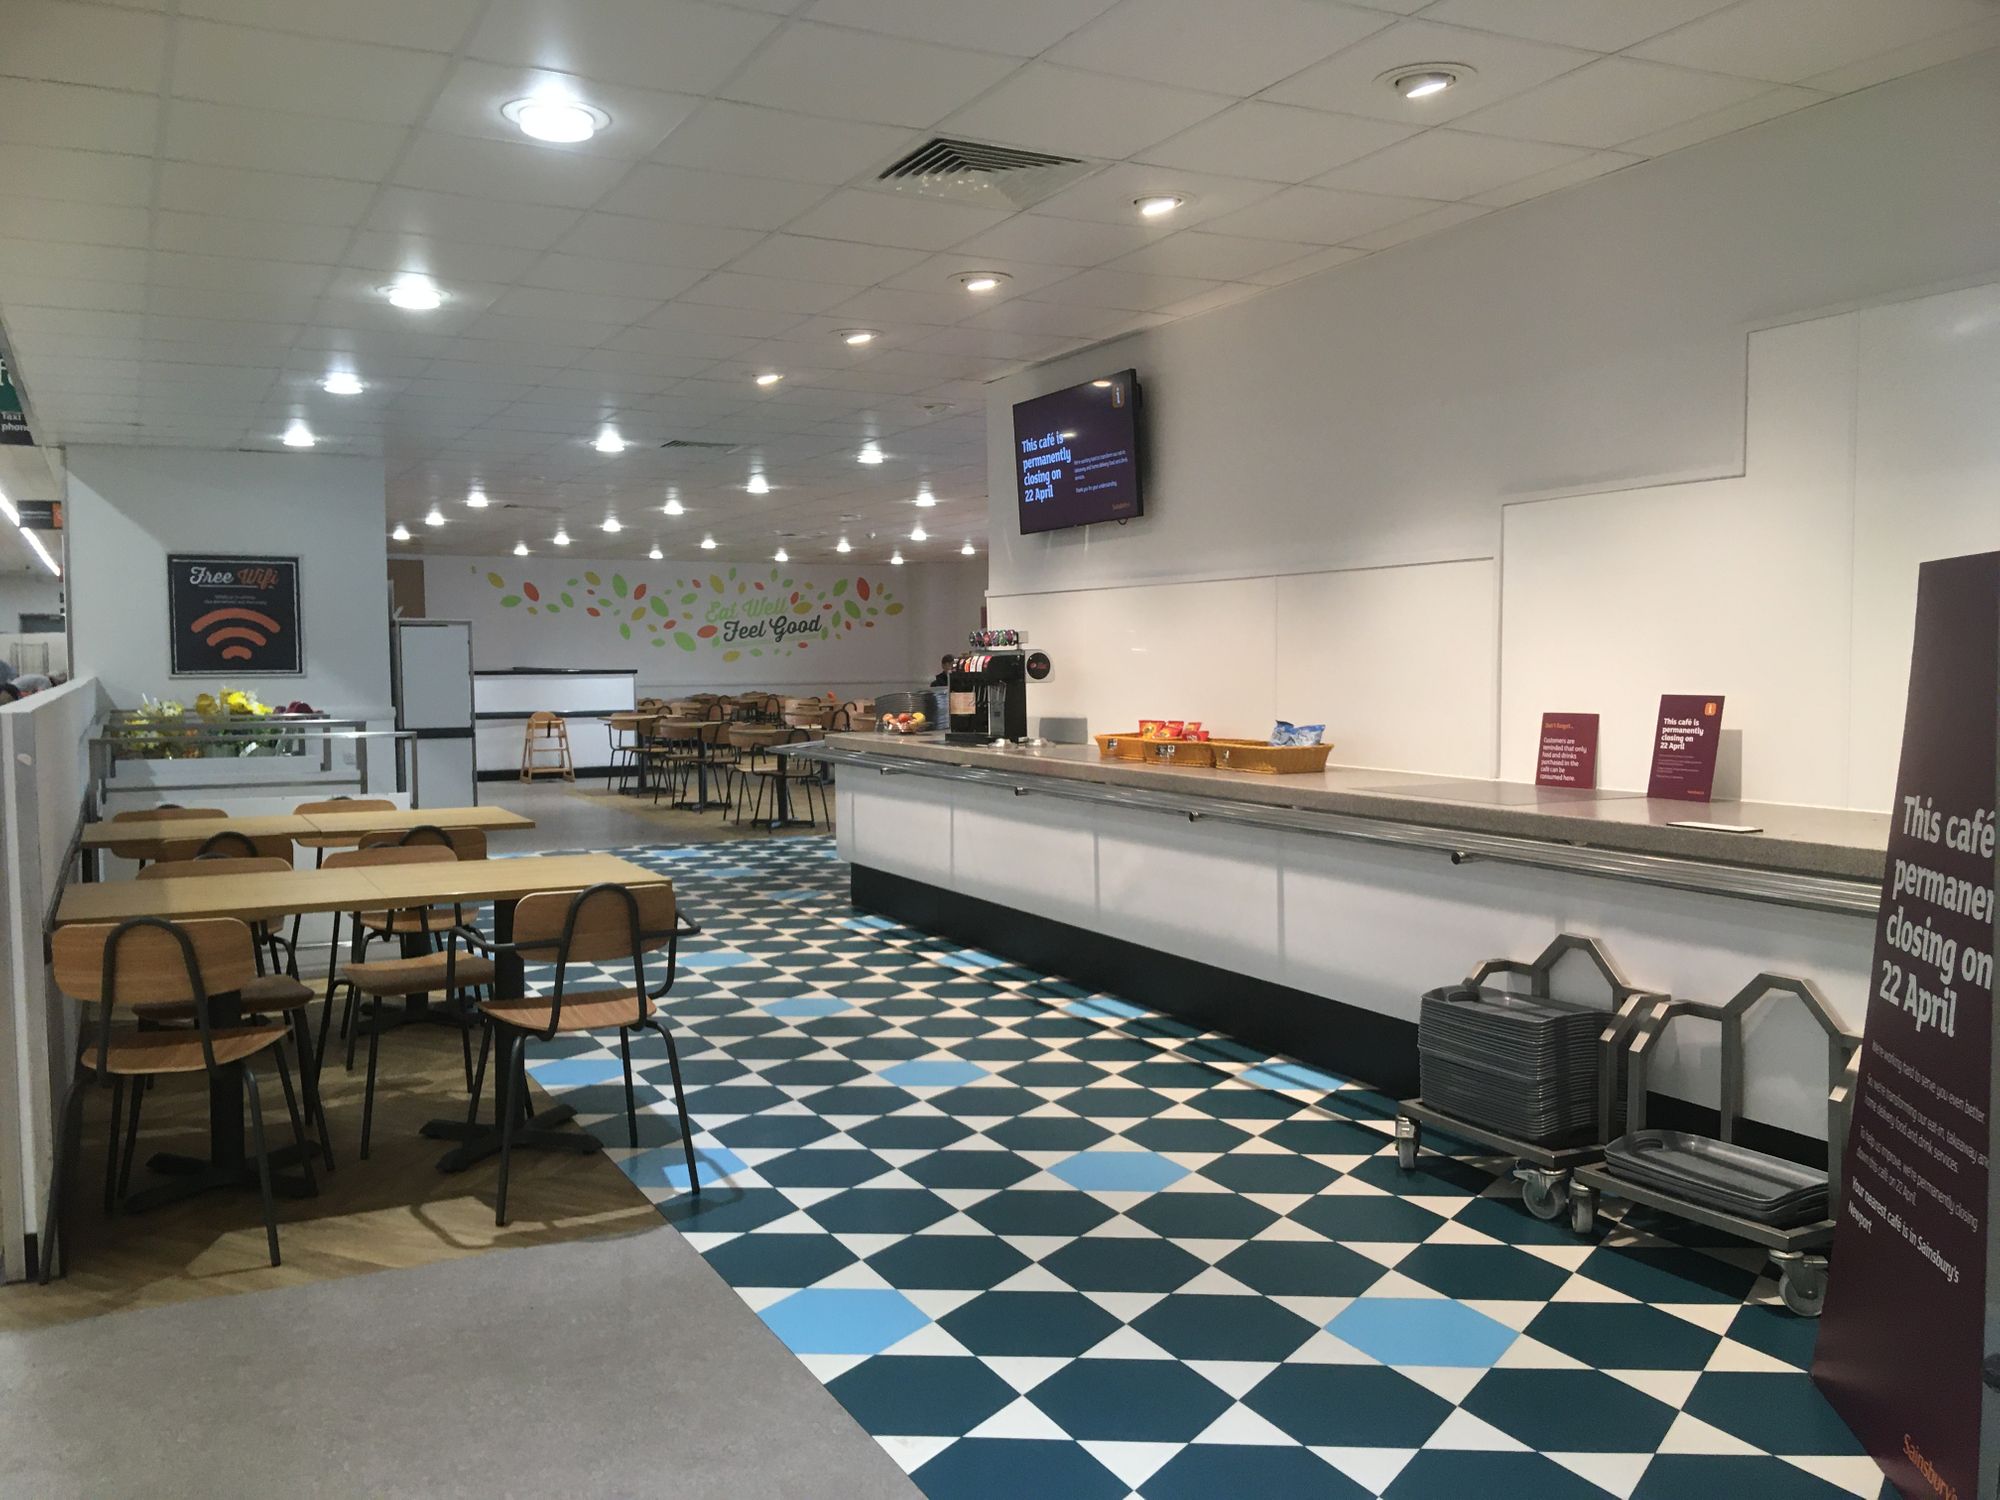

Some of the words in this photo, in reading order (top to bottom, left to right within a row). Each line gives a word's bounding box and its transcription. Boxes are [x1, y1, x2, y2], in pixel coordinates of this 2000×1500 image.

[2, 412, 22, 420] Taxi
[1022, 438, 1038, 453] This
[1039, 432, 1055, 449] café
[1056, 430, 1064, 444] is
[1022, 446, 1072, 473] permanently
[1024, 469, 1051, 486] closing
[1051, 468, 1062, 480] on
[1024, 489, 1034, 503] 22
[1035, 484, 1054, 503] April
[189, 566, 234, 585] Free
[237, 567, 279, 590] Wifi
[704, 600, 737, 623] Eat
[742, 596, 789, 618] Well
[723, 619, 767, 643] Feel
[768, 614, 823, 643] Good
[1662, 726, 1704, 736] permanently
[1663, 717, 1677, 726] This
[1678, 717, 1693, 727] café
[1693, 718, 1700, 727] is
[1575, 745, 1588, 754] only
[1660, 742, 1668, 750] 22
[1668, 742, 1685, 751] April
[1661, 735, 1684, 743] closing
[1561, 752, 1577, 760] drinks
[1903, 795, 1942, 844] This
[1945, 808, 1996, 858] café
[1886, 905, 1957, 985] closing
[1961, 947, 1993, 990] on
[1880, 960, 1902, 1007] 22
[1903, 972, 1957, 1038] April
[1921, 1075, 1936, 1093] serve
[1936, 1086, 1948, 1101] you
[1948, 1093, 1964, 1111] even
[1895, 1115, 1907, 1136] food
[1907, 1127, 1918, 1145] and
[1918, 1134, 1933, 1155] drink
[1917, 1112, 1927, 1126] our
[1946, 1129, 1977, 1164] takeaway
[1848, 1200, 1872, 1234] Newport
[1917, 1175, 1954, 1215] permanently
[1955, 1202, 1978, 1233] closing
[1852, 1175, 1864, 1198] Your
[1864, 1191, 1887, 1219] nearest
[1887, 1212, 1901, 1232] café
[1902, 1221, 1908, 1238] is
[1909, 1227, 1917, 1246] in
[1917, 1236, 1960, 1284] Sainsbury's
